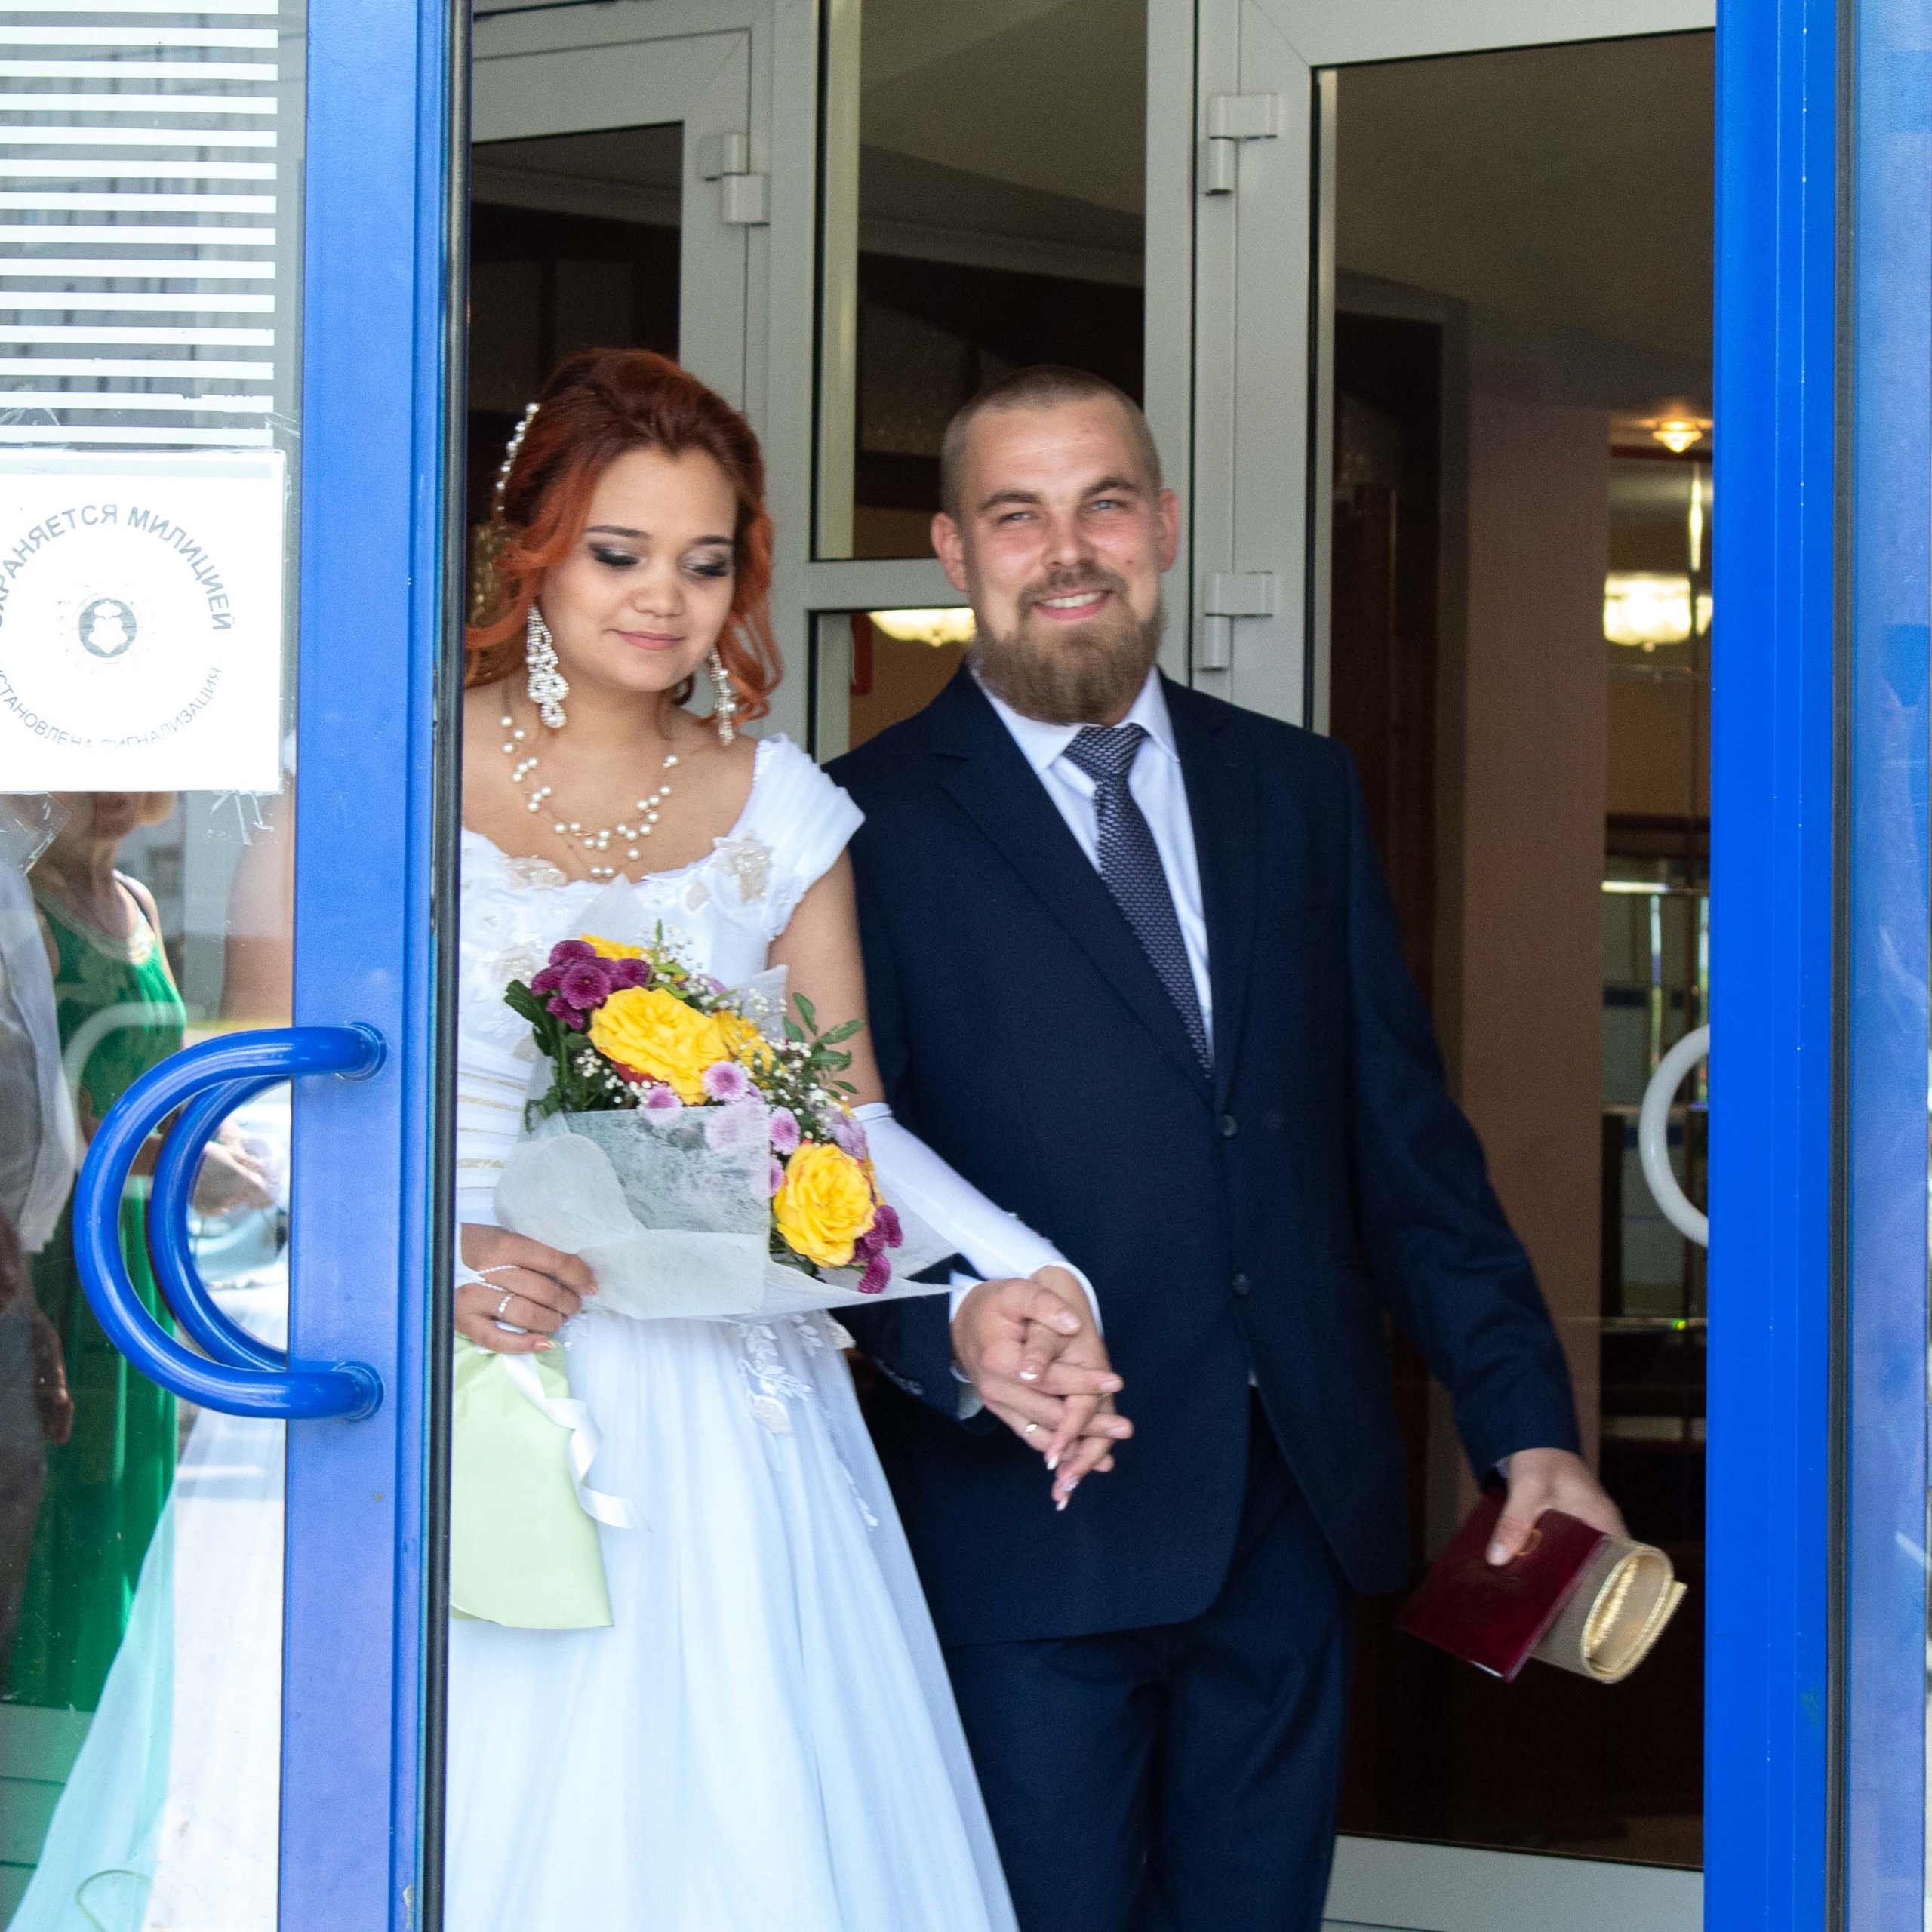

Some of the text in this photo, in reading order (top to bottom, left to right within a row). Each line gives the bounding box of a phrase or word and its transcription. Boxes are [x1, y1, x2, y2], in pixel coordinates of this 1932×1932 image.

[0, 503, 235, 631] РАНЯЕТСЯ МИЛИЦИЕЙ
[0, 669, 93, 747] СТАНОВЛЕНА
